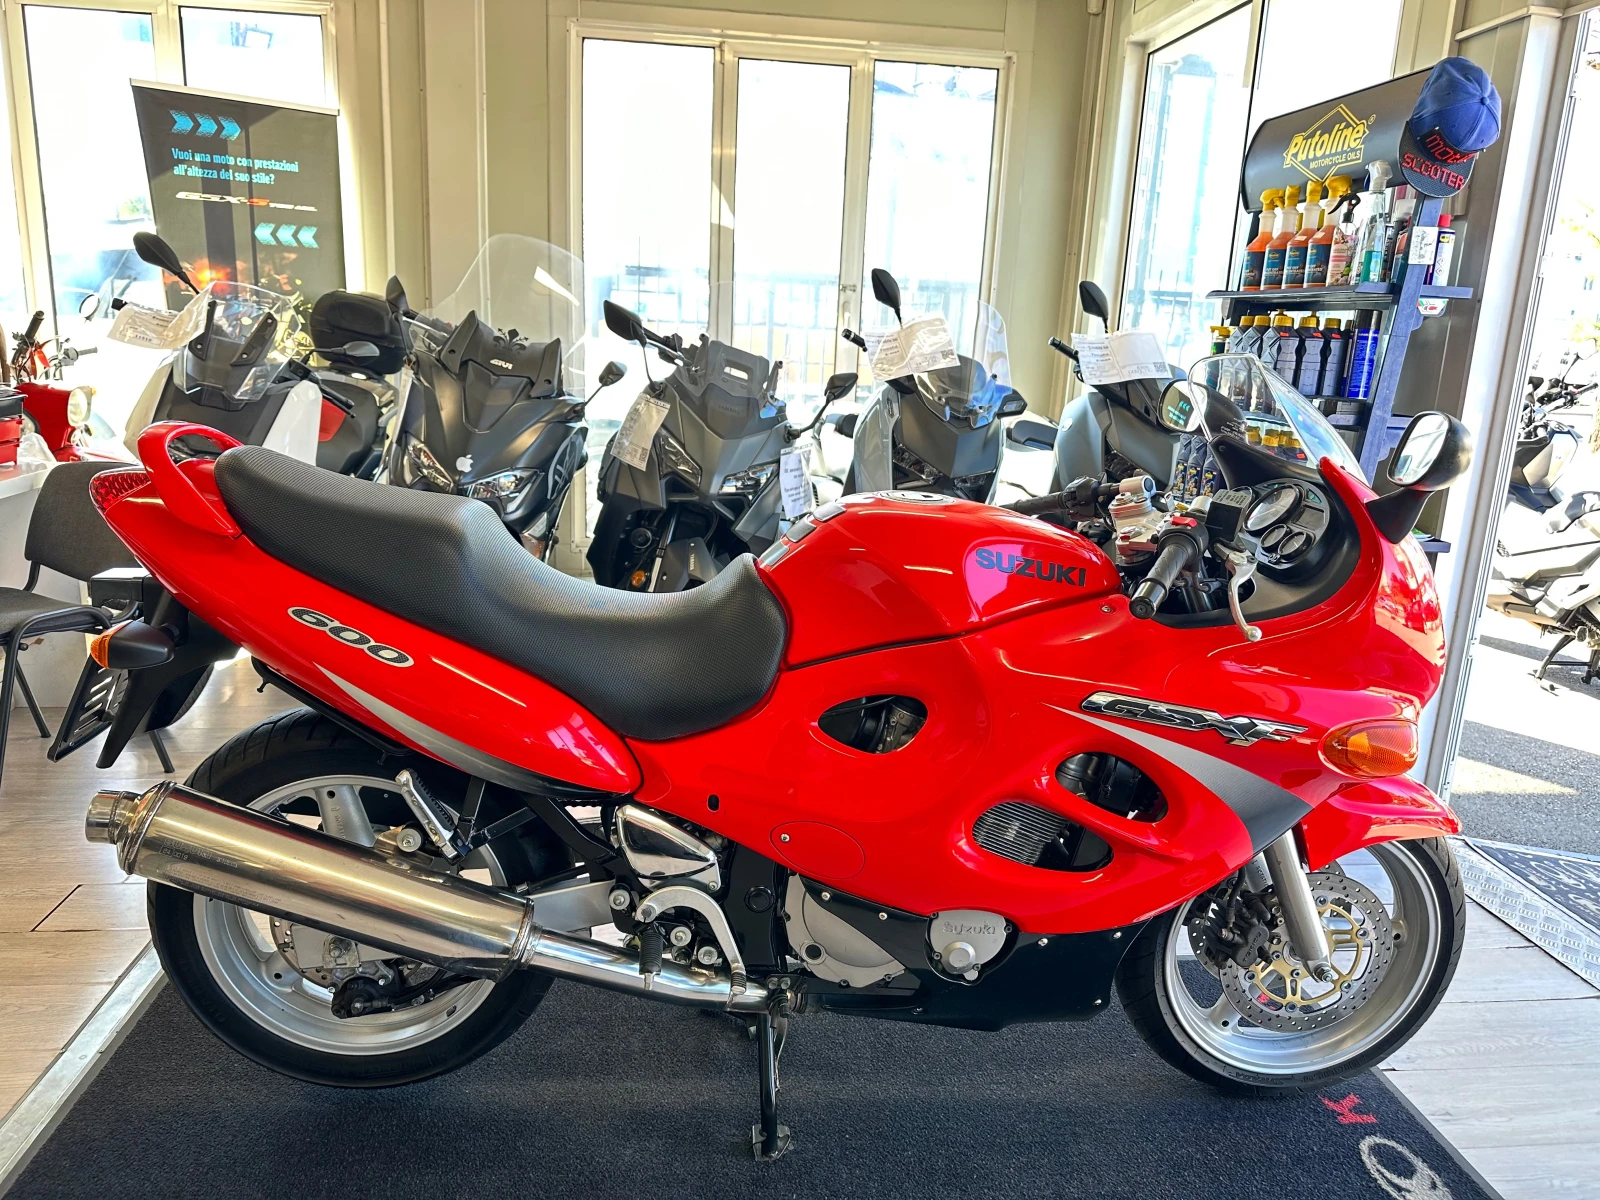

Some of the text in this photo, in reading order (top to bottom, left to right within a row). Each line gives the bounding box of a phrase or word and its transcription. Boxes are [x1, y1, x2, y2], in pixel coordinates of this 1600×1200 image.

[171, 148, 299, 172] Vuoi una moto con prestazioni
[1285, 122, 1365, 165] Putoline
[1309, 150, 1361, 169] MOTORCYCLE OILS
[173, 164, 275, 184] all'altezza del suo stile?
[1402, 152, 1465, 190] SCOOTER
[976, 548, 1086, 588] SUZUKI
[287, 606, 415, 668] 600
